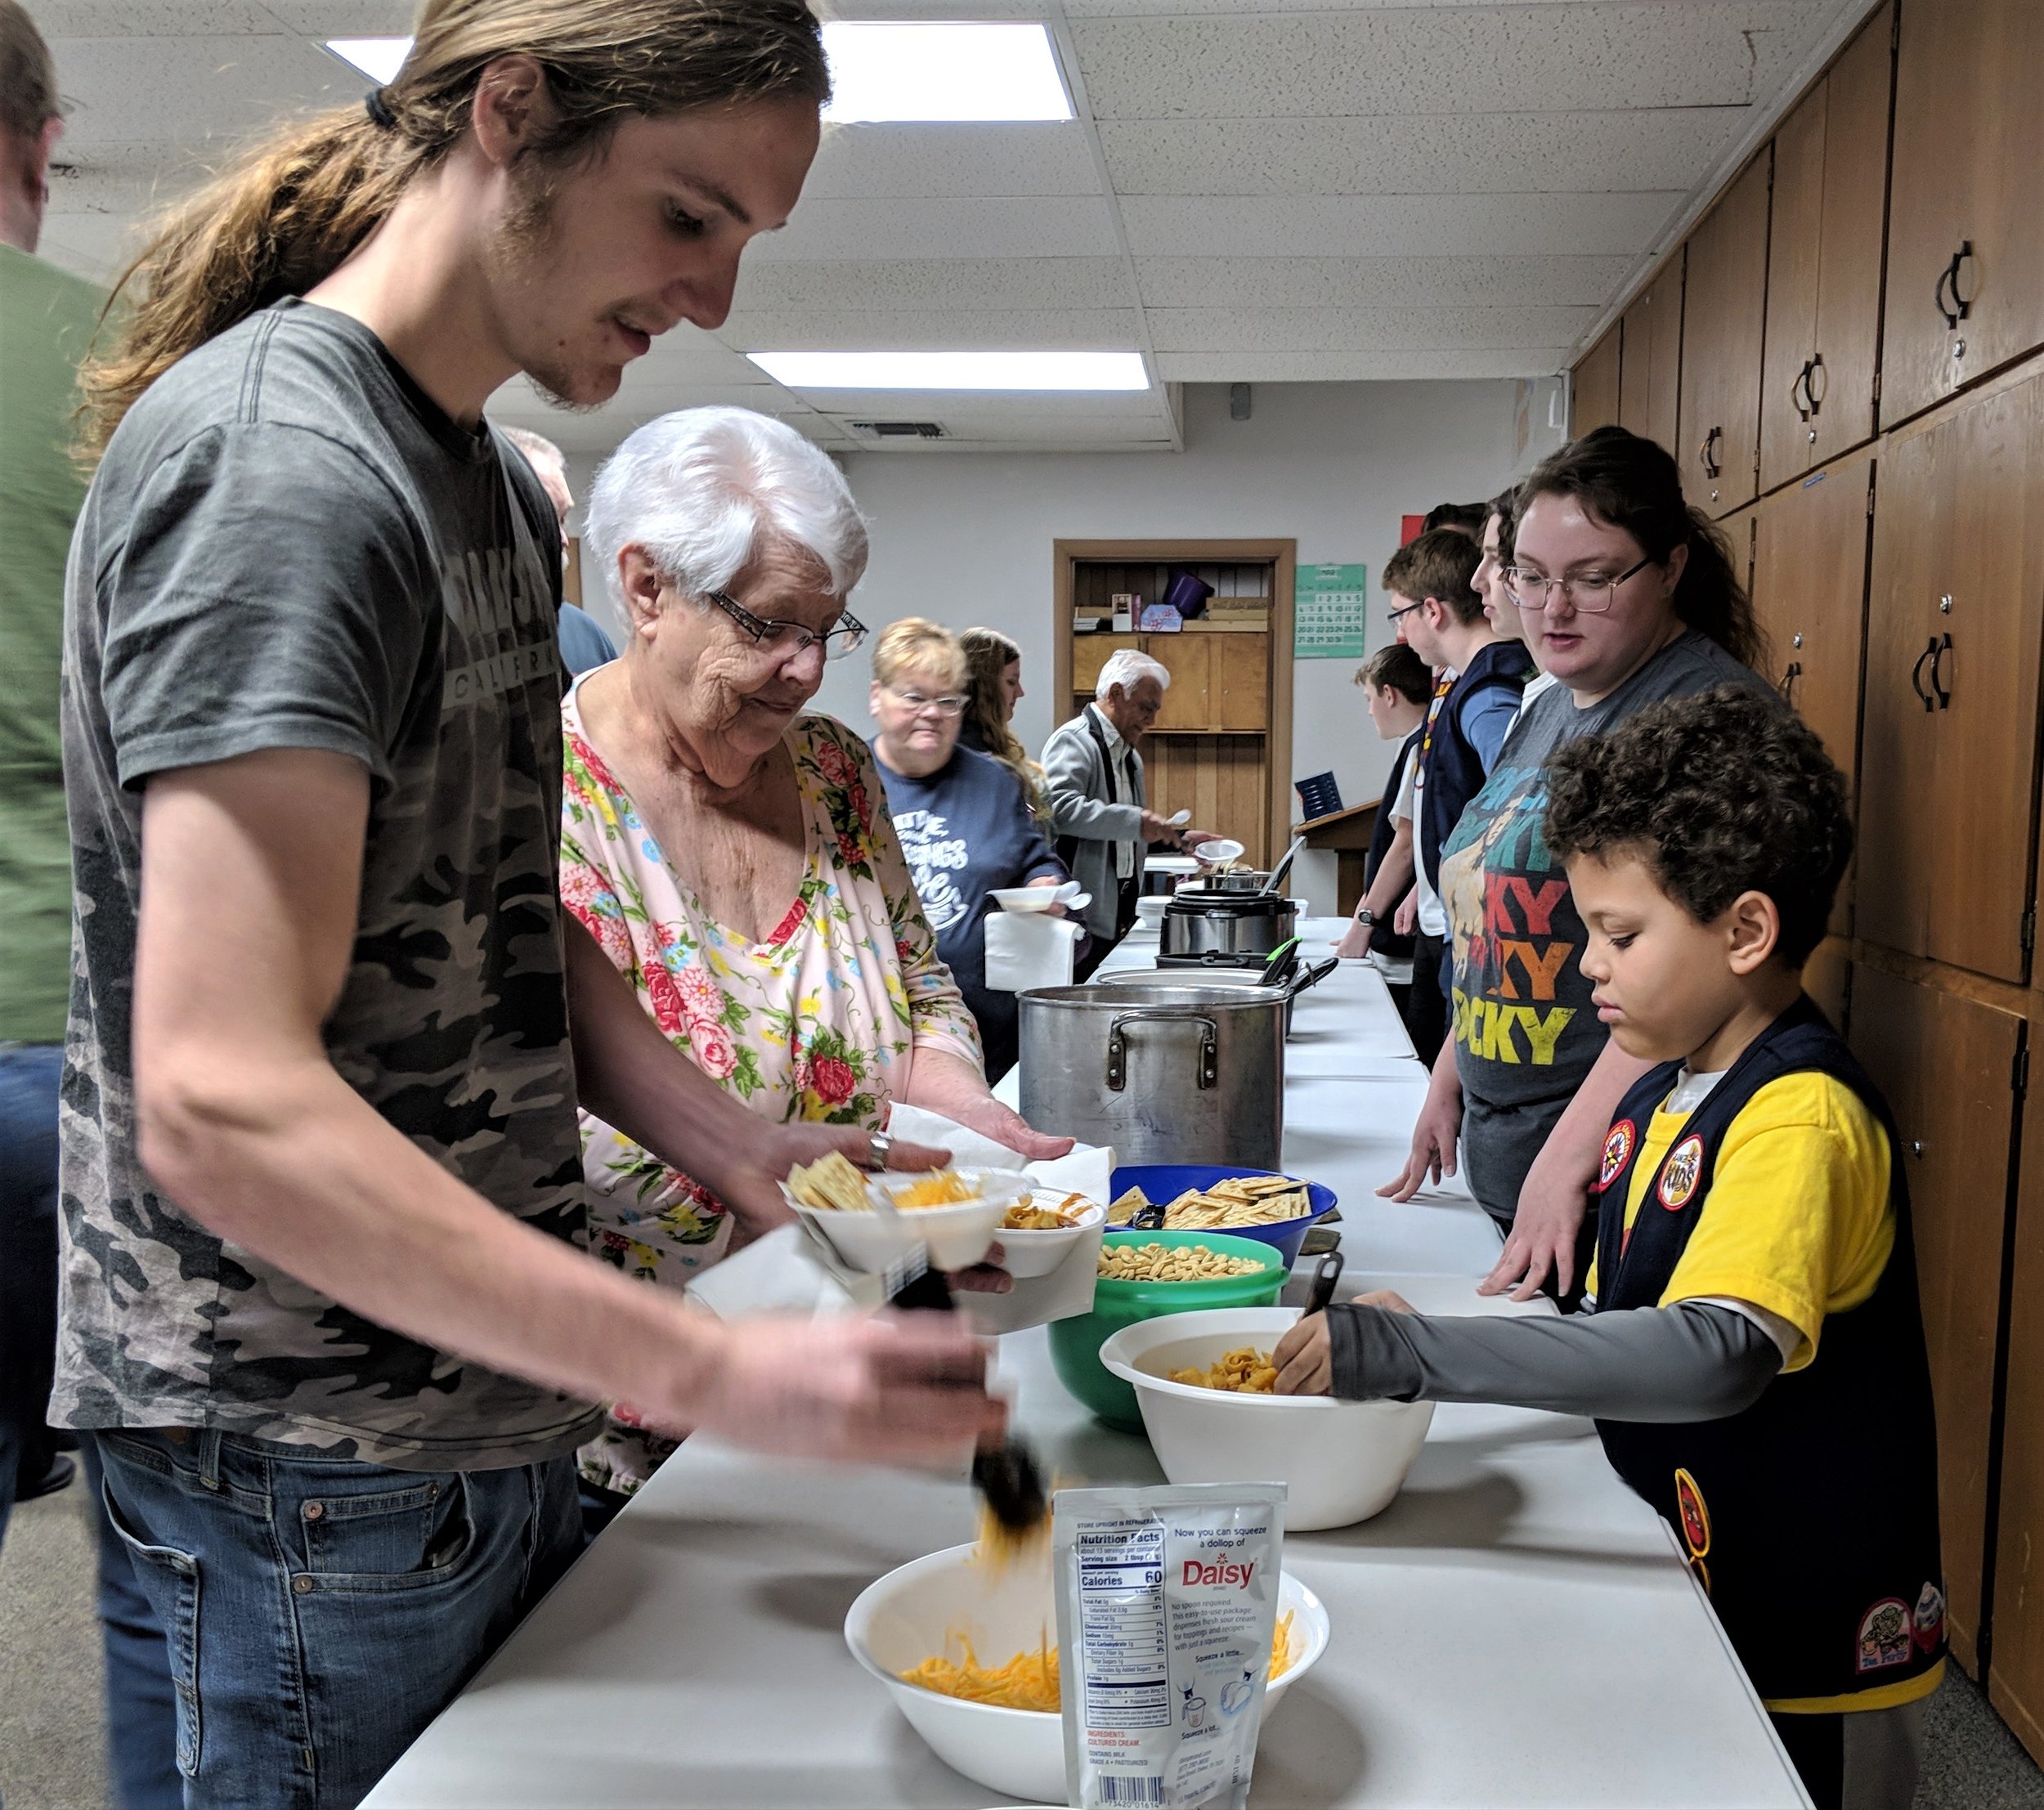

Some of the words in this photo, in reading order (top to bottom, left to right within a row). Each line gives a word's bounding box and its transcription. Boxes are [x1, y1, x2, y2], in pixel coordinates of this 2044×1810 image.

[1175, 1529, 1195, 1537] Now
[1198, 1529, 1213, 1538] you
[1234, 1527, 1266, 1536] squeeze
[1081, 1534, 1127, 1543] Nutrition
[1131, 1533, 1159, 1543] Facts
[1207, 1539, 1234, 1548] dollop
[1236, 1538, 1245, 1546] of
[1182, 1553, 1254, 1590] Daisy
[1083, 1576, 1123, 1586] Calories
[1145, 1570, 1162, 1583] 60
[1185, 1609, 1221, 1618] easy-to-use
[1195, 1654, 1218, 1662] Squeeze
